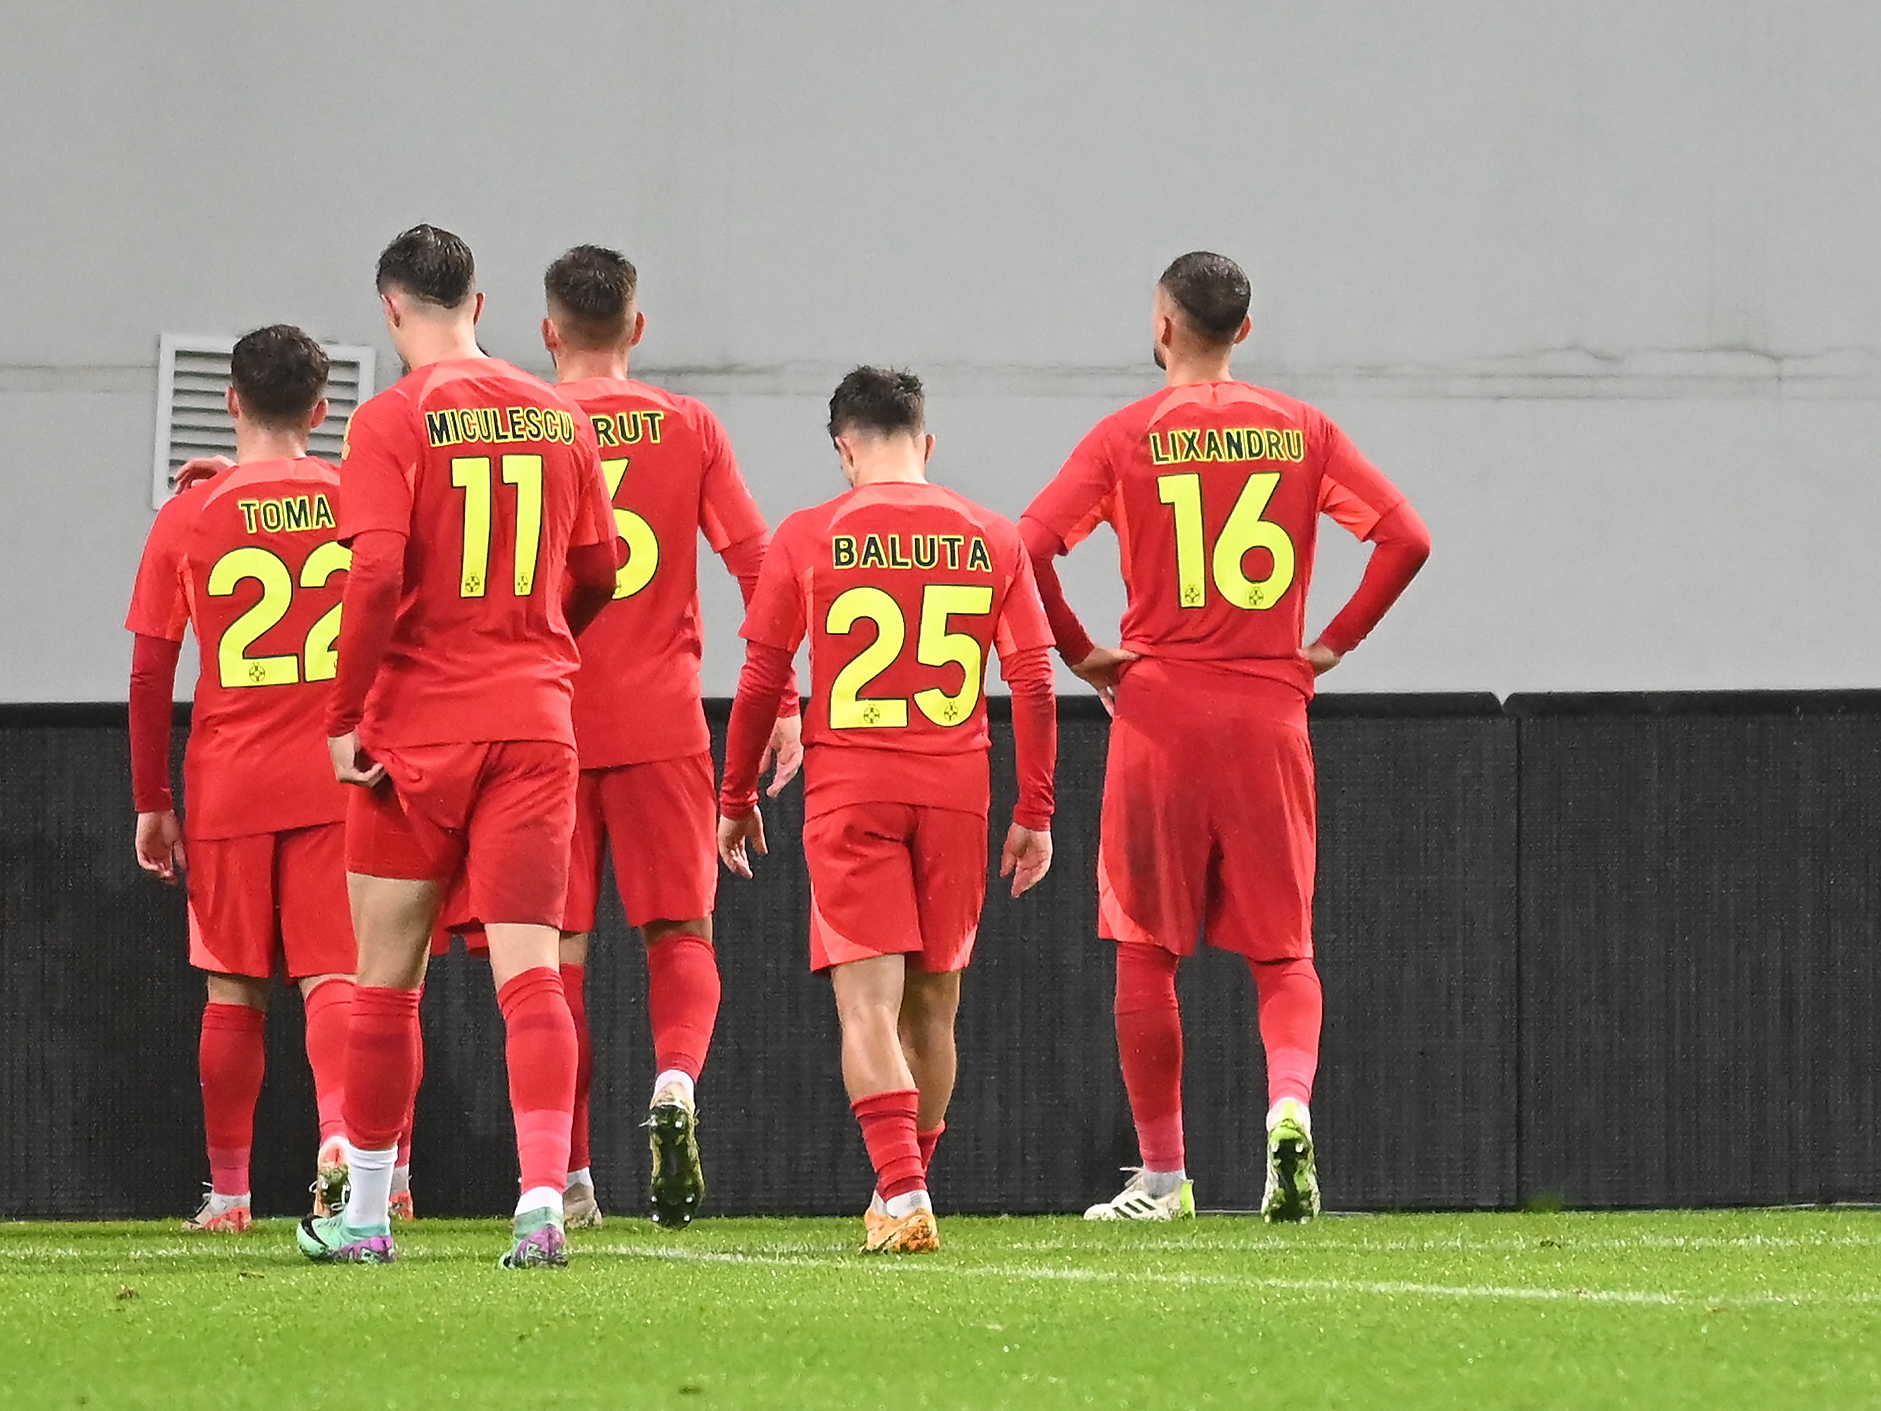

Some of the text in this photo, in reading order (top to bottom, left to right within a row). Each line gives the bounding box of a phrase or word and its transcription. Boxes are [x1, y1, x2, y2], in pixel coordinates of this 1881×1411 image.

[425, 406, 576, 447] MICULESCU
[1149, 427, 1306, 465] LIXANDRU
[238, 493, 336, 535] TOMA
[451, 453, 544, 599] 11
[832, 533, 994, 573] BALUTA
[1157, 470, 1296, 610] 16
[207, 539, 354, 689] 22
[825, 583, 995, 731] 25
